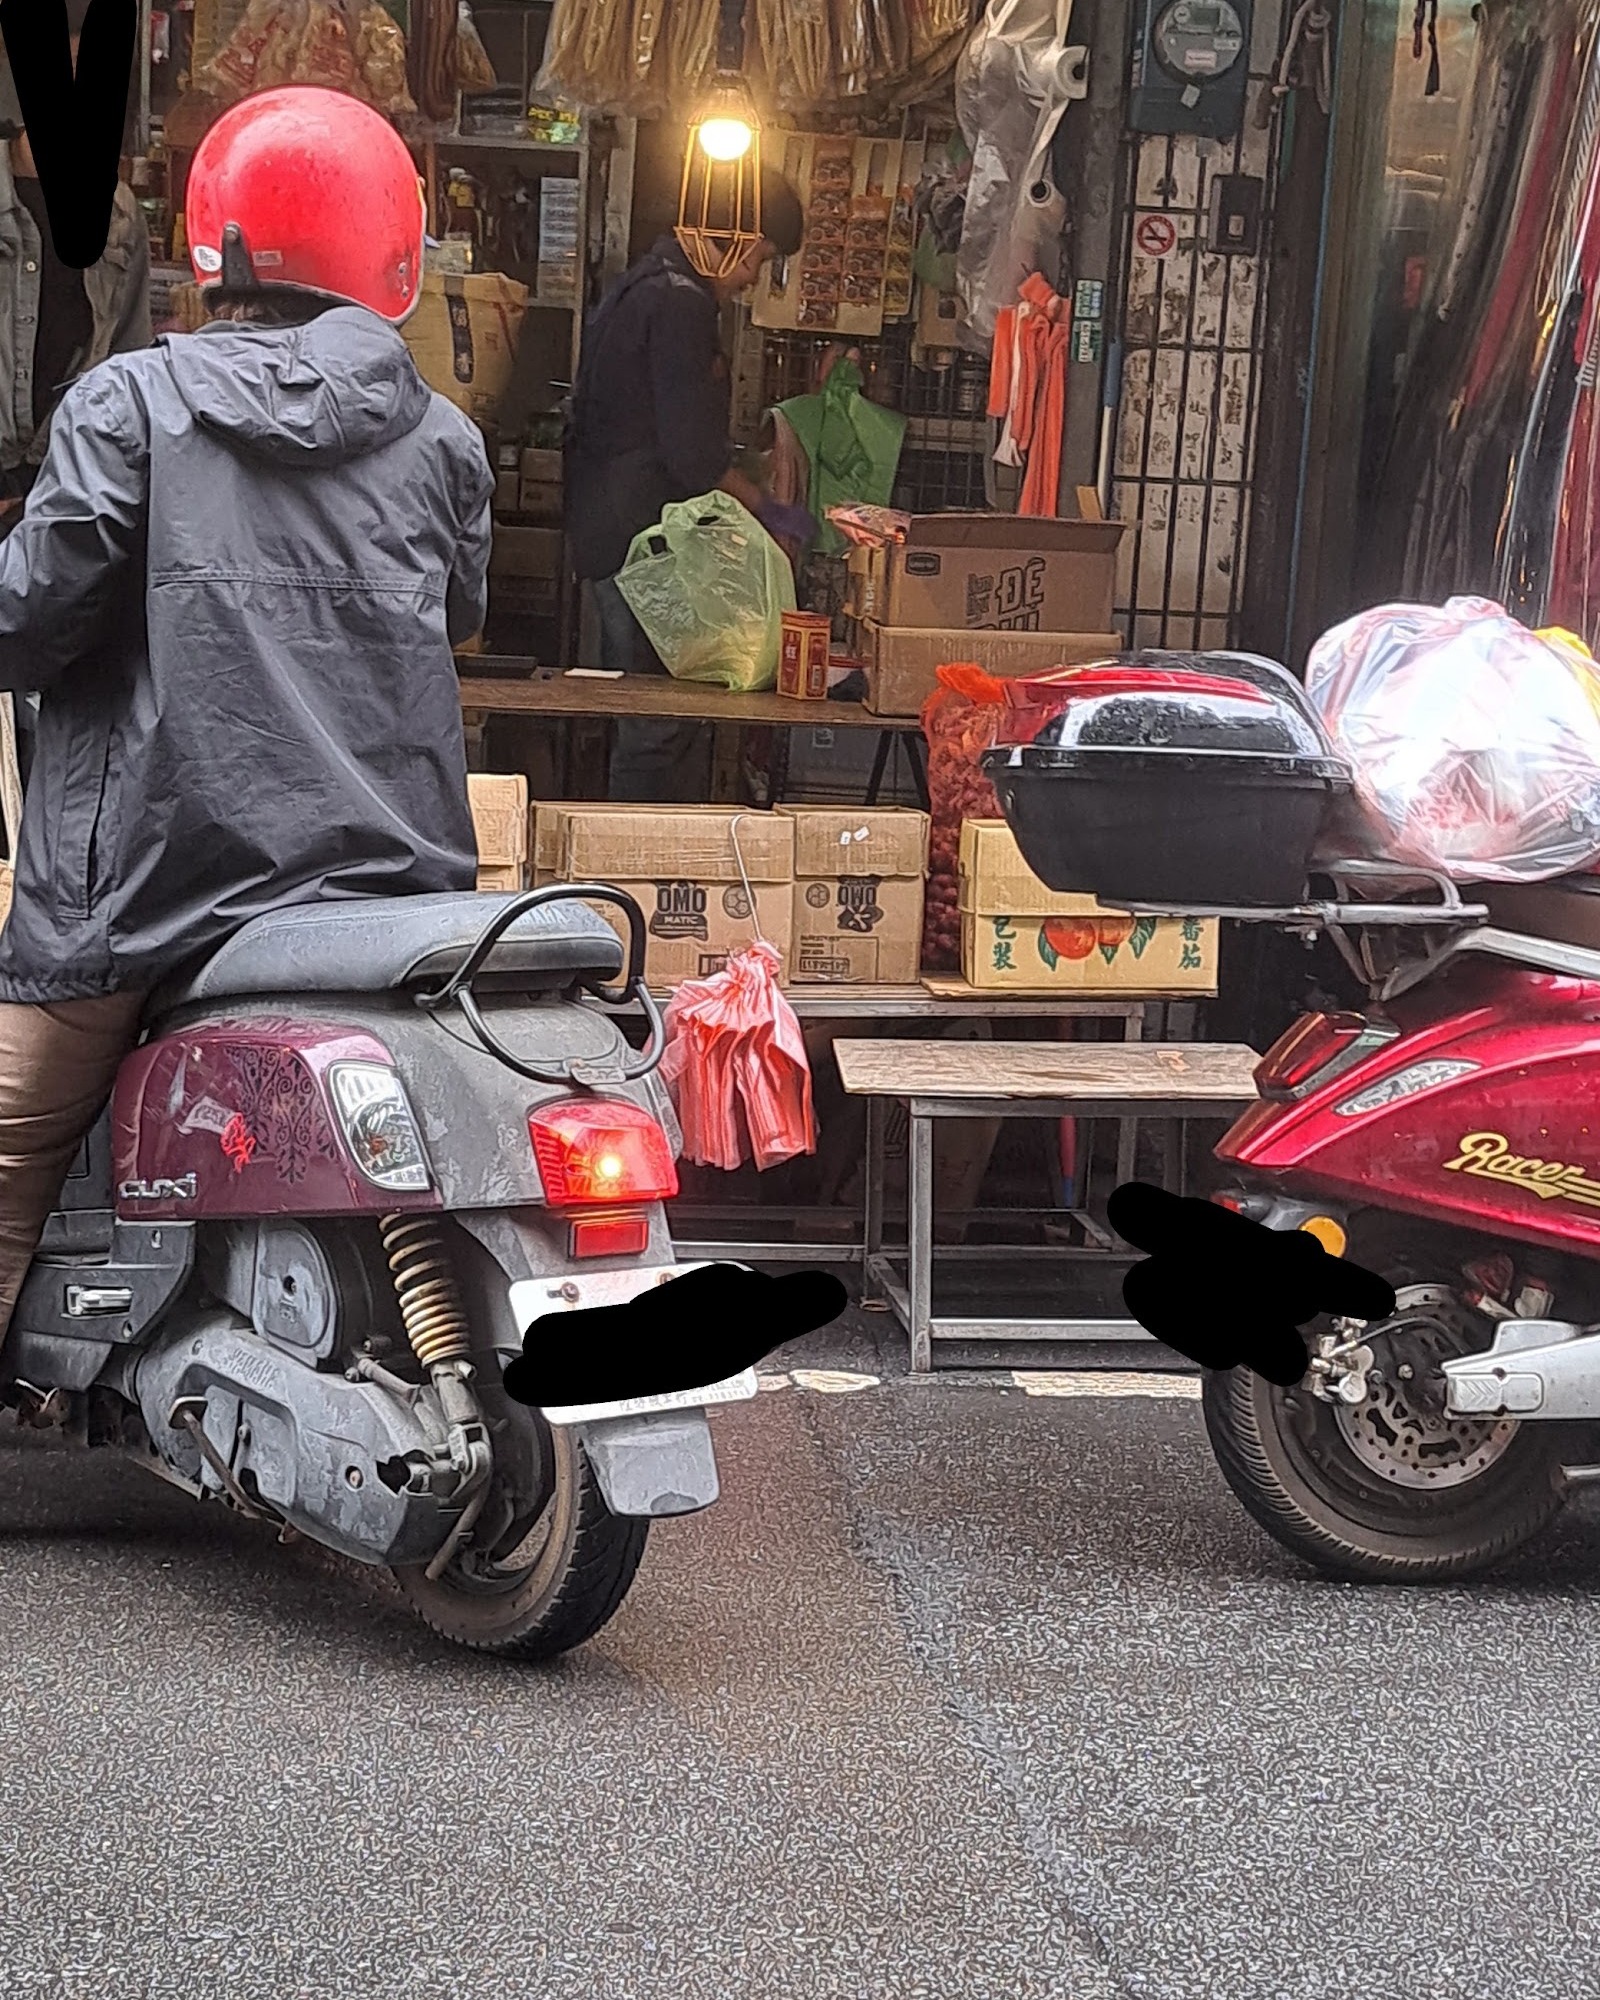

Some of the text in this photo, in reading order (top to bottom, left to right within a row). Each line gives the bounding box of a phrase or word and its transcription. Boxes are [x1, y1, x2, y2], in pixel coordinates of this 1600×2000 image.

[656, 887, 707, 914] OMO
[663, 915, 699, 925] MATIC
[1441, 1131, 1587, 1186] Racer
